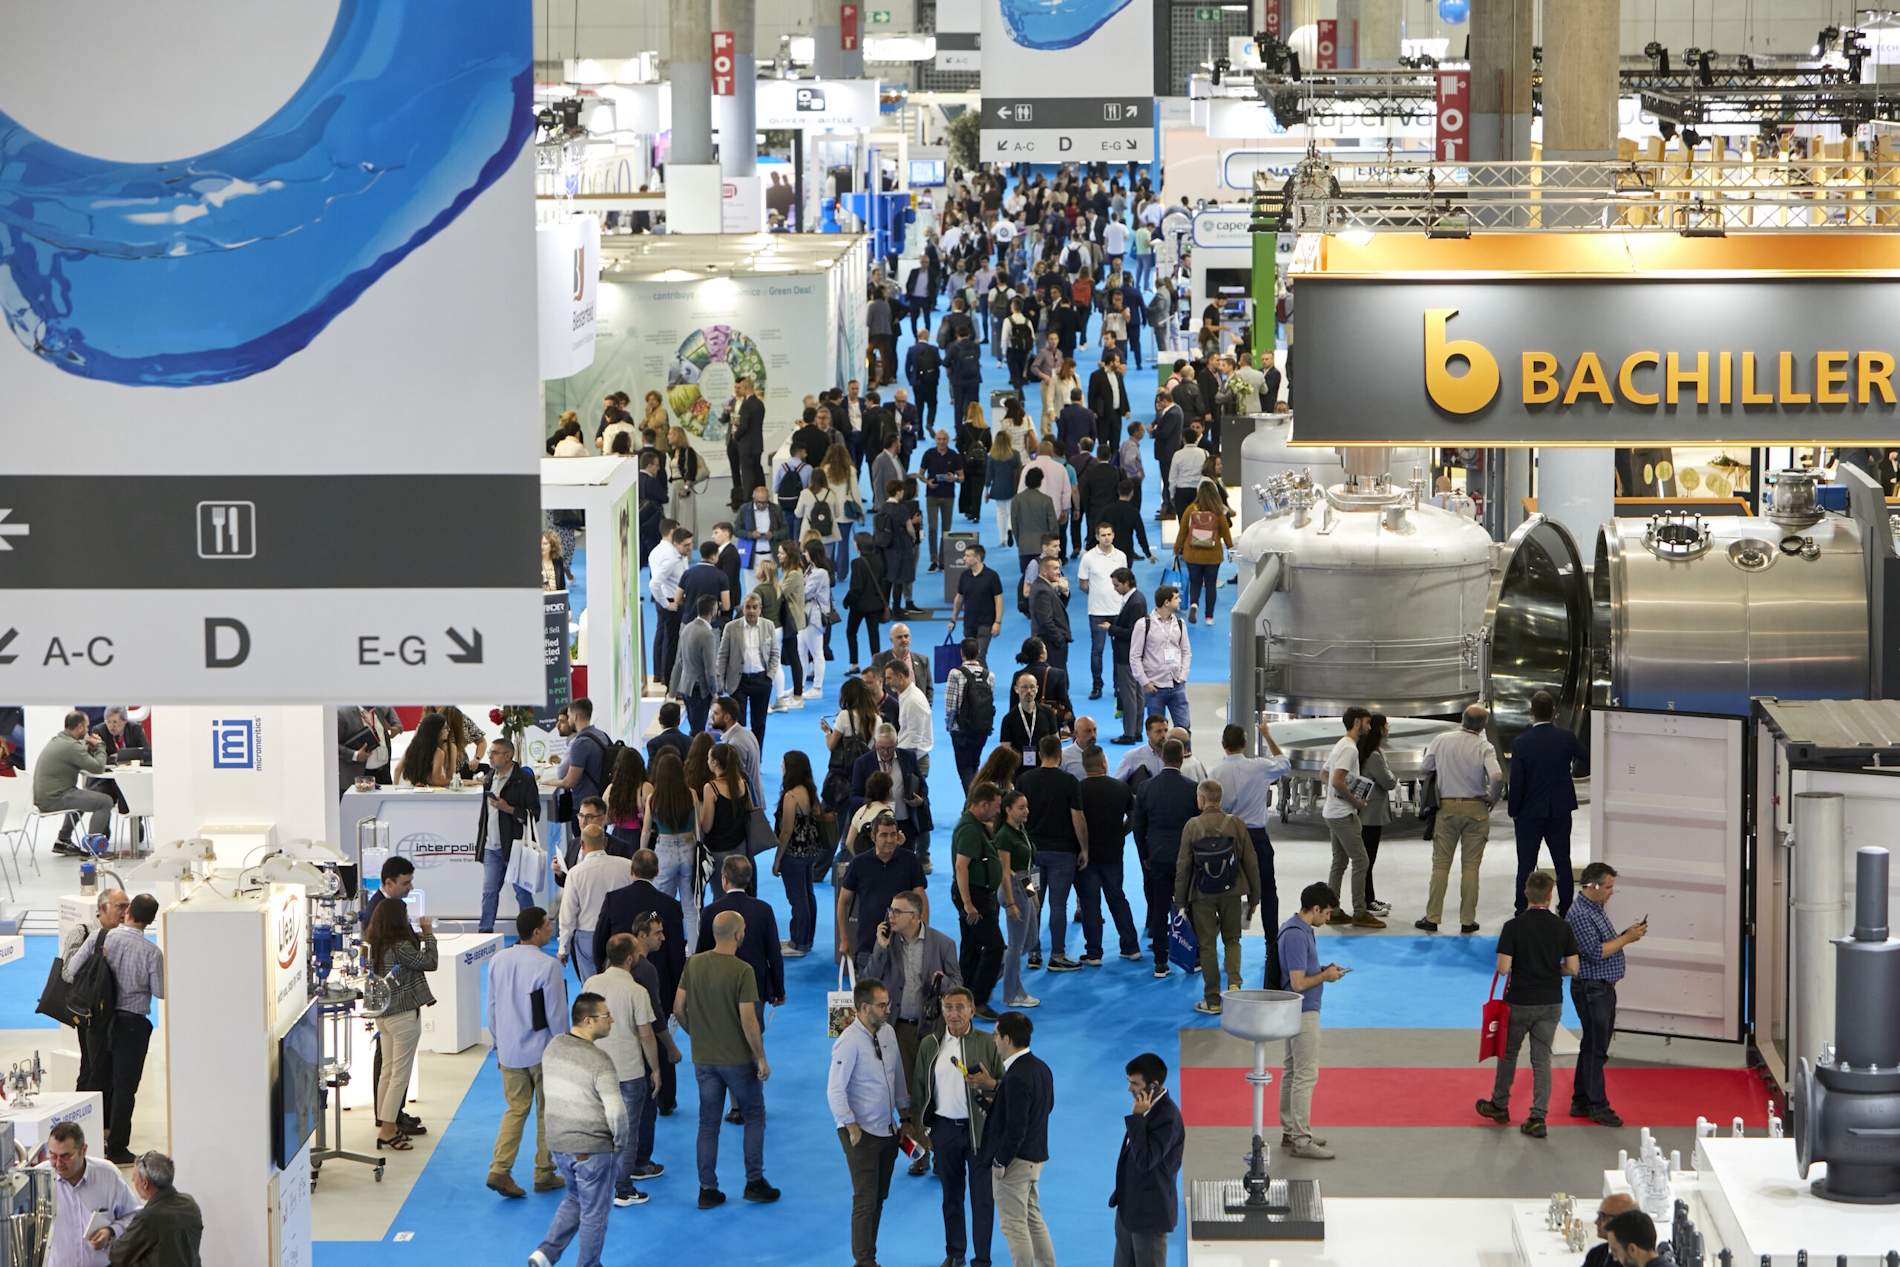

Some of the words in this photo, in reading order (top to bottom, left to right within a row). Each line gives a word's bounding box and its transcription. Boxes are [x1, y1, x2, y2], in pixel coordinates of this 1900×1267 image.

[1014, 142, 1035, 151] A-C
[1059, 136, 1073, 152] D
[1101, 141, 1122, 151] E-G
[768, 286, 792, 296] Green
[1521, 350, 1898, 405] BACHILLER
[43, 635, 115, 667] A-C
[204, 616, 252, 669] D
[357, 635, 428, 667] E-G
